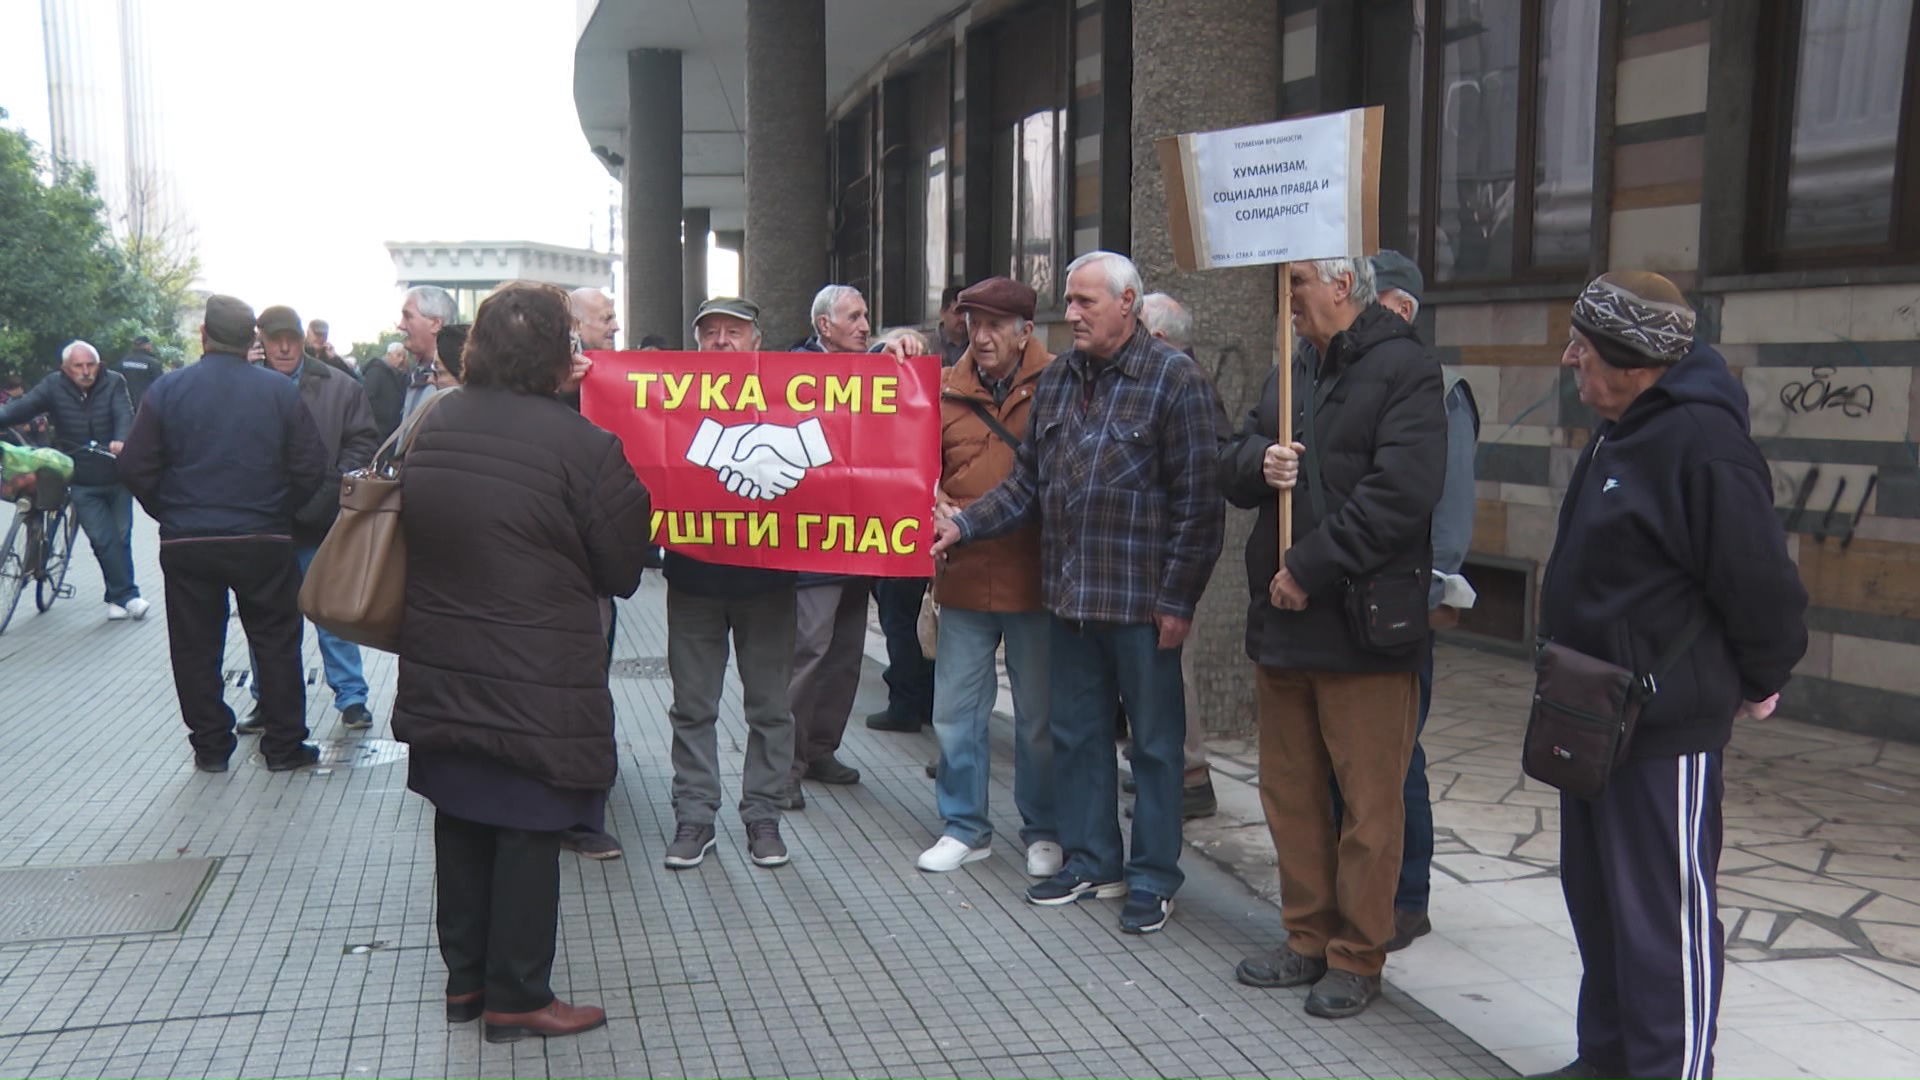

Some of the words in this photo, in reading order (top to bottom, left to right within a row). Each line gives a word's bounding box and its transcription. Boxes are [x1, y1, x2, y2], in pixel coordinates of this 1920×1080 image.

[1233, 160, 1308, 179] ХУМАНИЗАМ,
[1213, 186, 1278, 203] СОЦИЈАЛНА
[1280, 181, 1319, 196] ПРАВДА
[1321, 179, 1329, 189] И
[1235, 202, 1309, 221] СОЛИДАРНОСТ
[626, 372, 768, 412] ТУКА
[785, 374, 899, 414] СМЕ
[796, 514, 920, 555] ГЛАС
